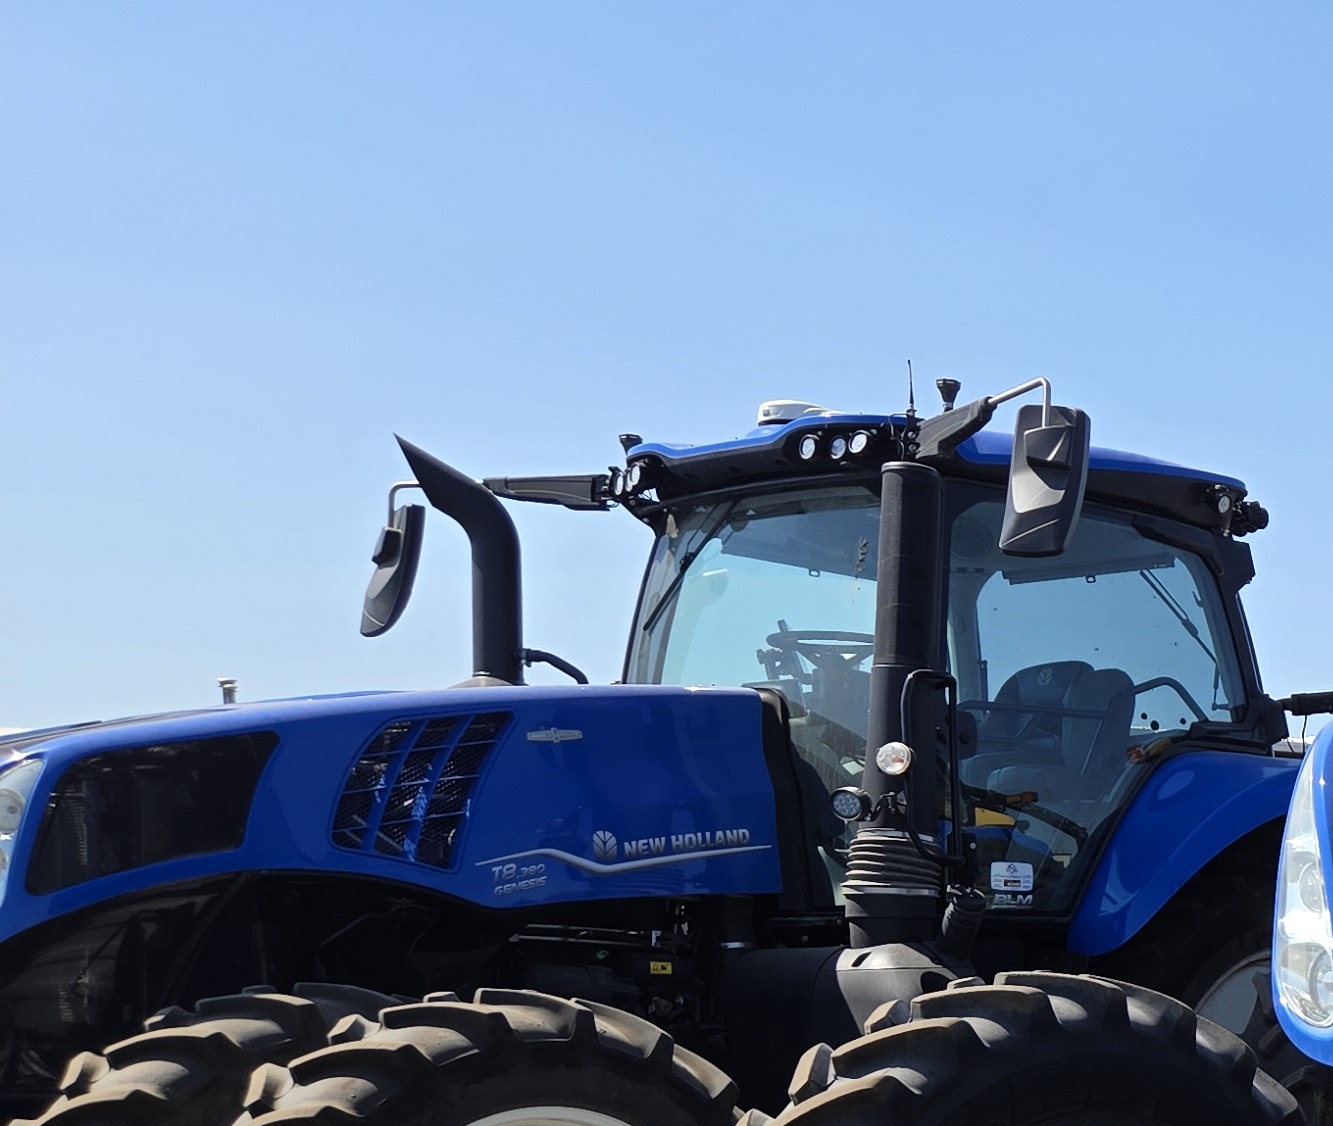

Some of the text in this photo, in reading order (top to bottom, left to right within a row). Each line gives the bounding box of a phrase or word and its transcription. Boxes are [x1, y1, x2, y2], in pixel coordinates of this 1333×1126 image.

[623, 828, 751, 859] NEW HOLLAND
[491, 862, 546, 882] T8.380
[493, 876, 548, 896] GENESIS
